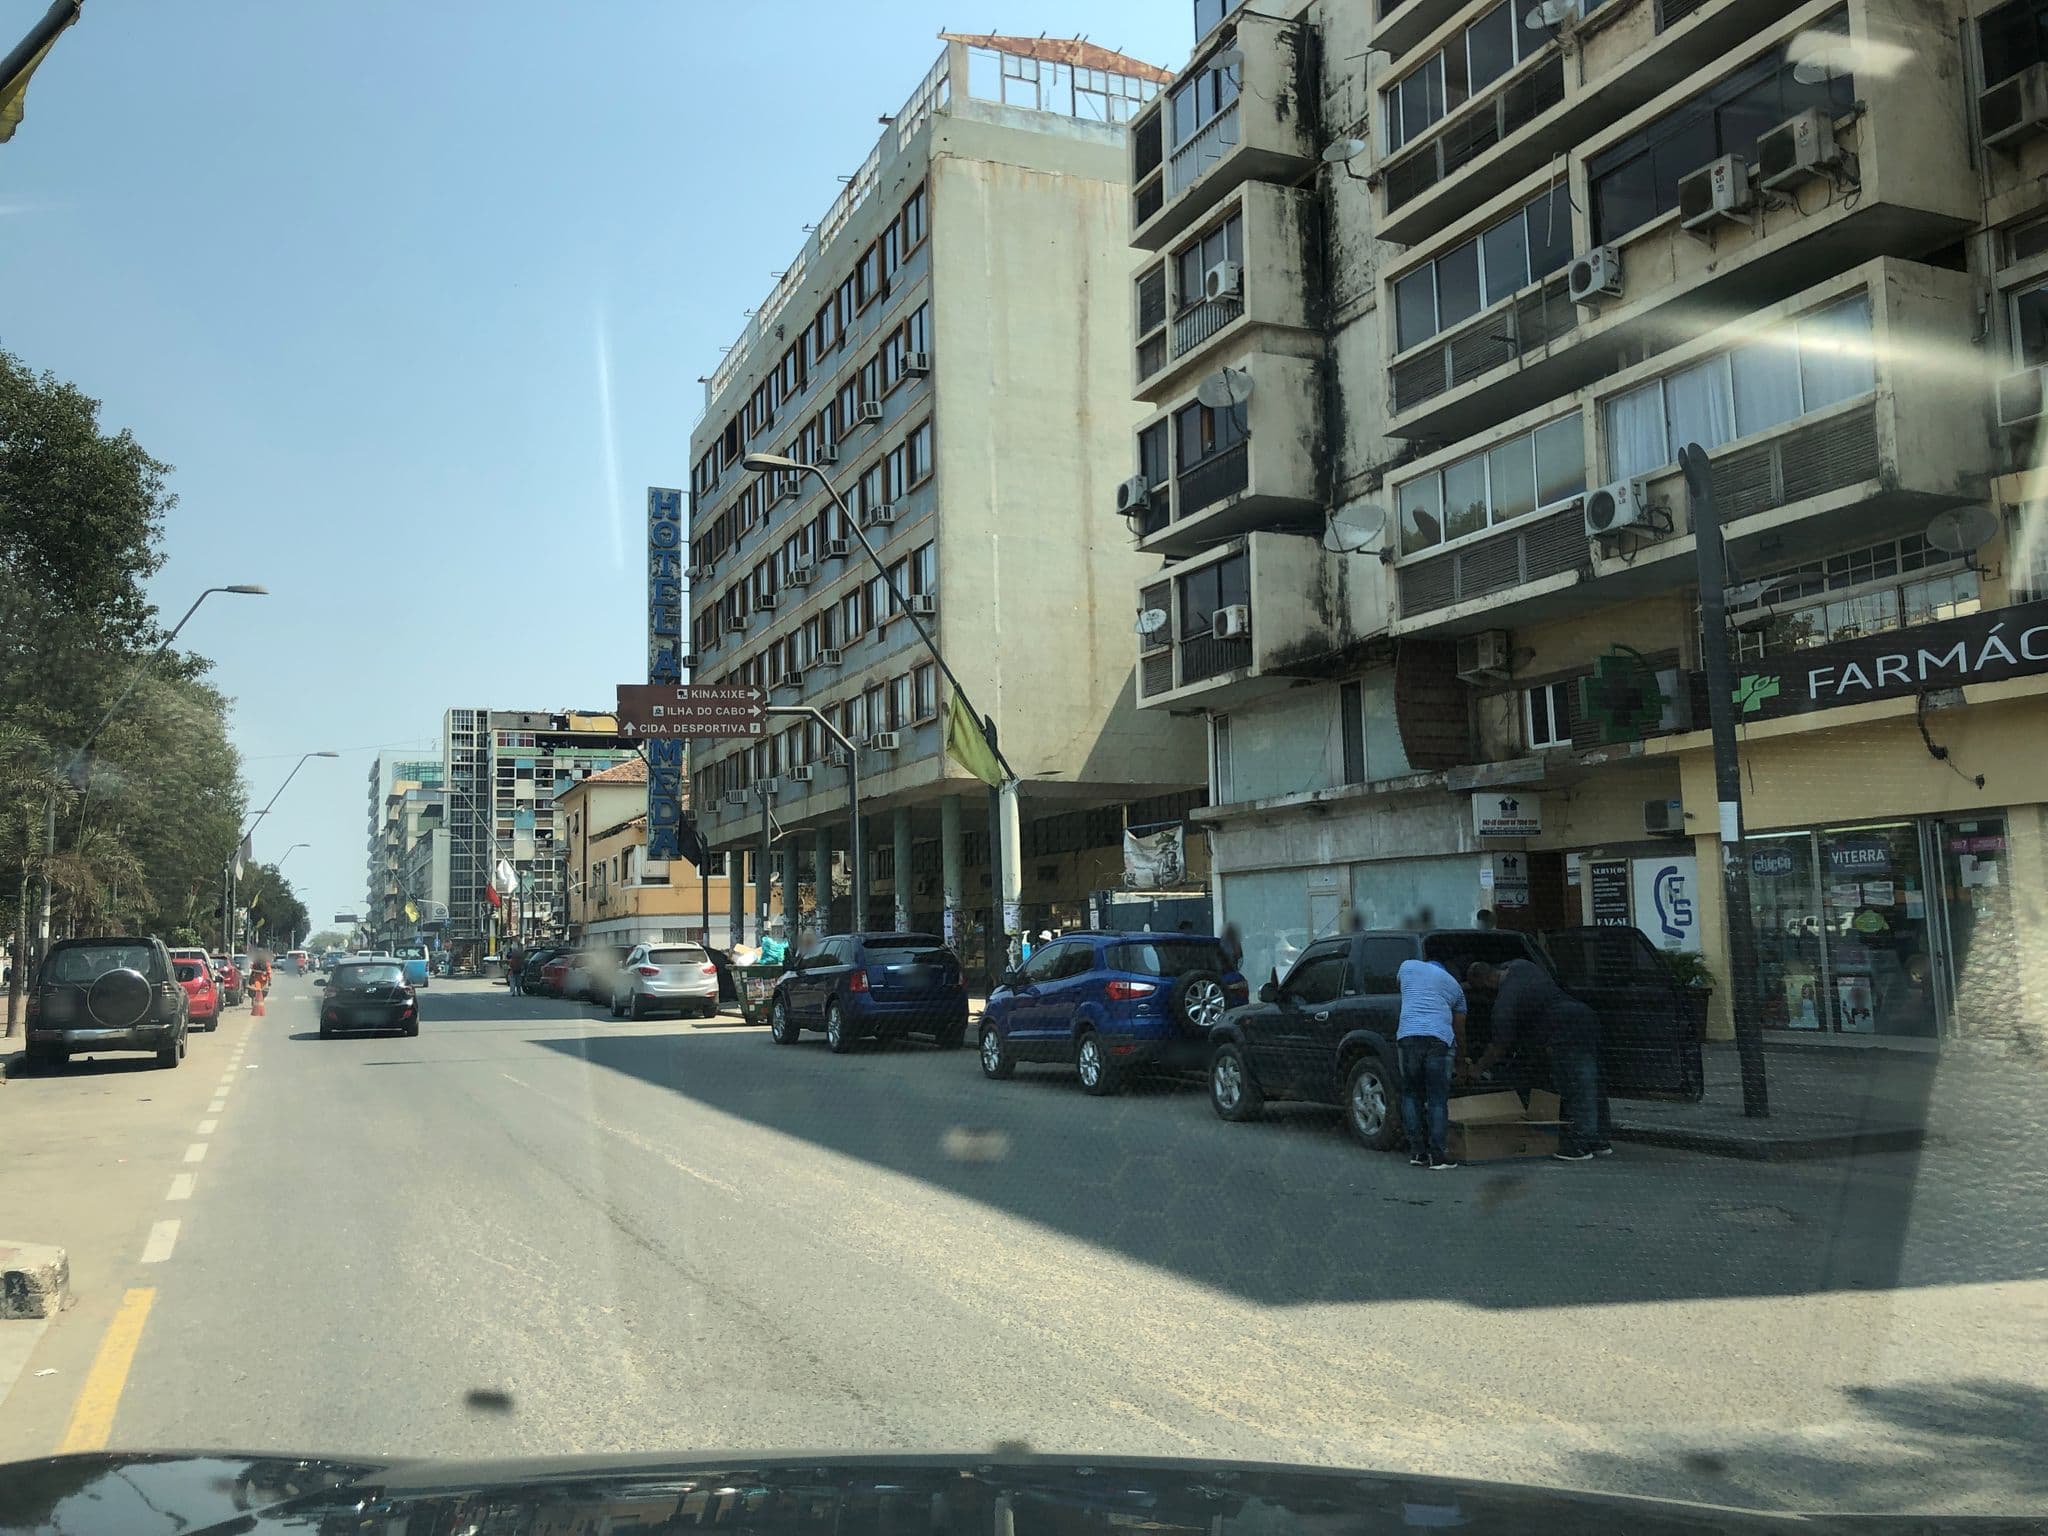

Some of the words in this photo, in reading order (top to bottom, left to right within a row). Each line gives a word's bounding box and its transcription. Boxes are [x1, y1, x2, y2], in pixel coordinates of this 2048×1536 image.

[653, 491, 681, 635] HOTEL
[1808, 622, 2048, 699] FARMÁC
[691, 690, 745, 699] KINAXIXE
[667, 706, 693, 715] ILHA
[697, 706, 712, 715] DO
[715, 706, 746, 715] CABO
[639, 724, 670, 733] CIDA.
[673, 724, 746, 733] DESPORTIVA
[653, 651, 681, 858] AMEDA
[1832, 849, 1885, 864] VITERRA
